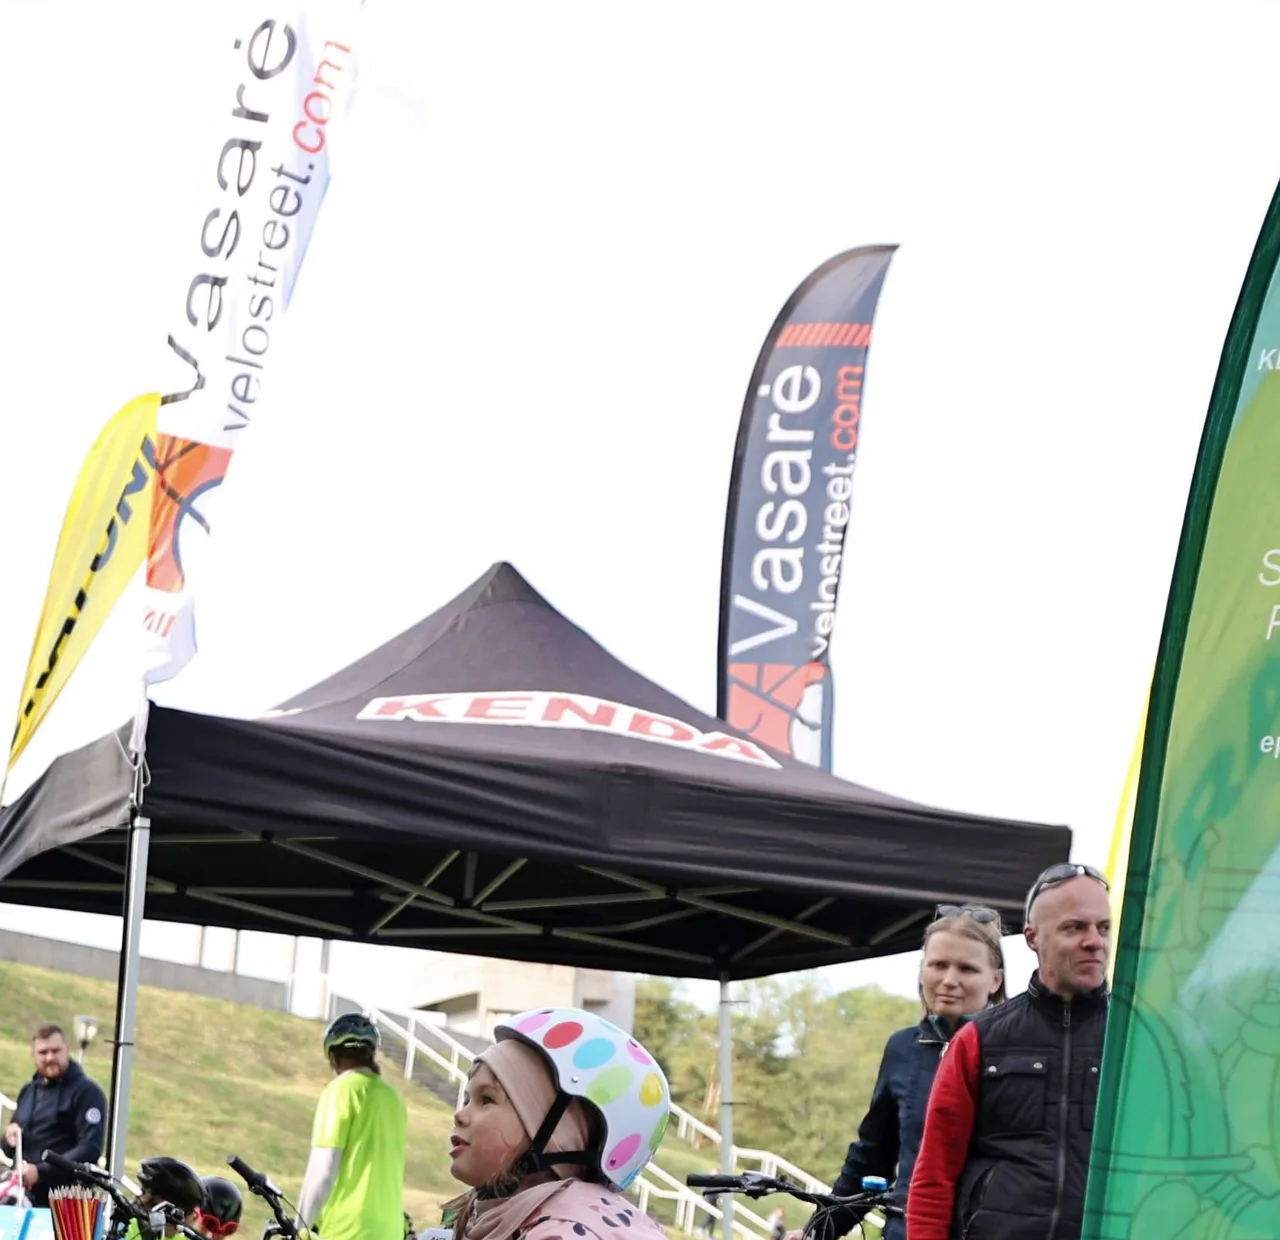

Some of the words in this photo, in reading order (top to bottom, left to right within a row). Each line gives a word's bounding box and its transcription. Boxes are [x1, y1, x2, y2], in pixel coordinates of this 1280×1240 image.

[160, 18, 297, 406] Vasarė
[222, 40, 351, 431] velostreet.com
[728, 364, 822, 656] Vasarė
[373, 696, 770, 762] KENDA
